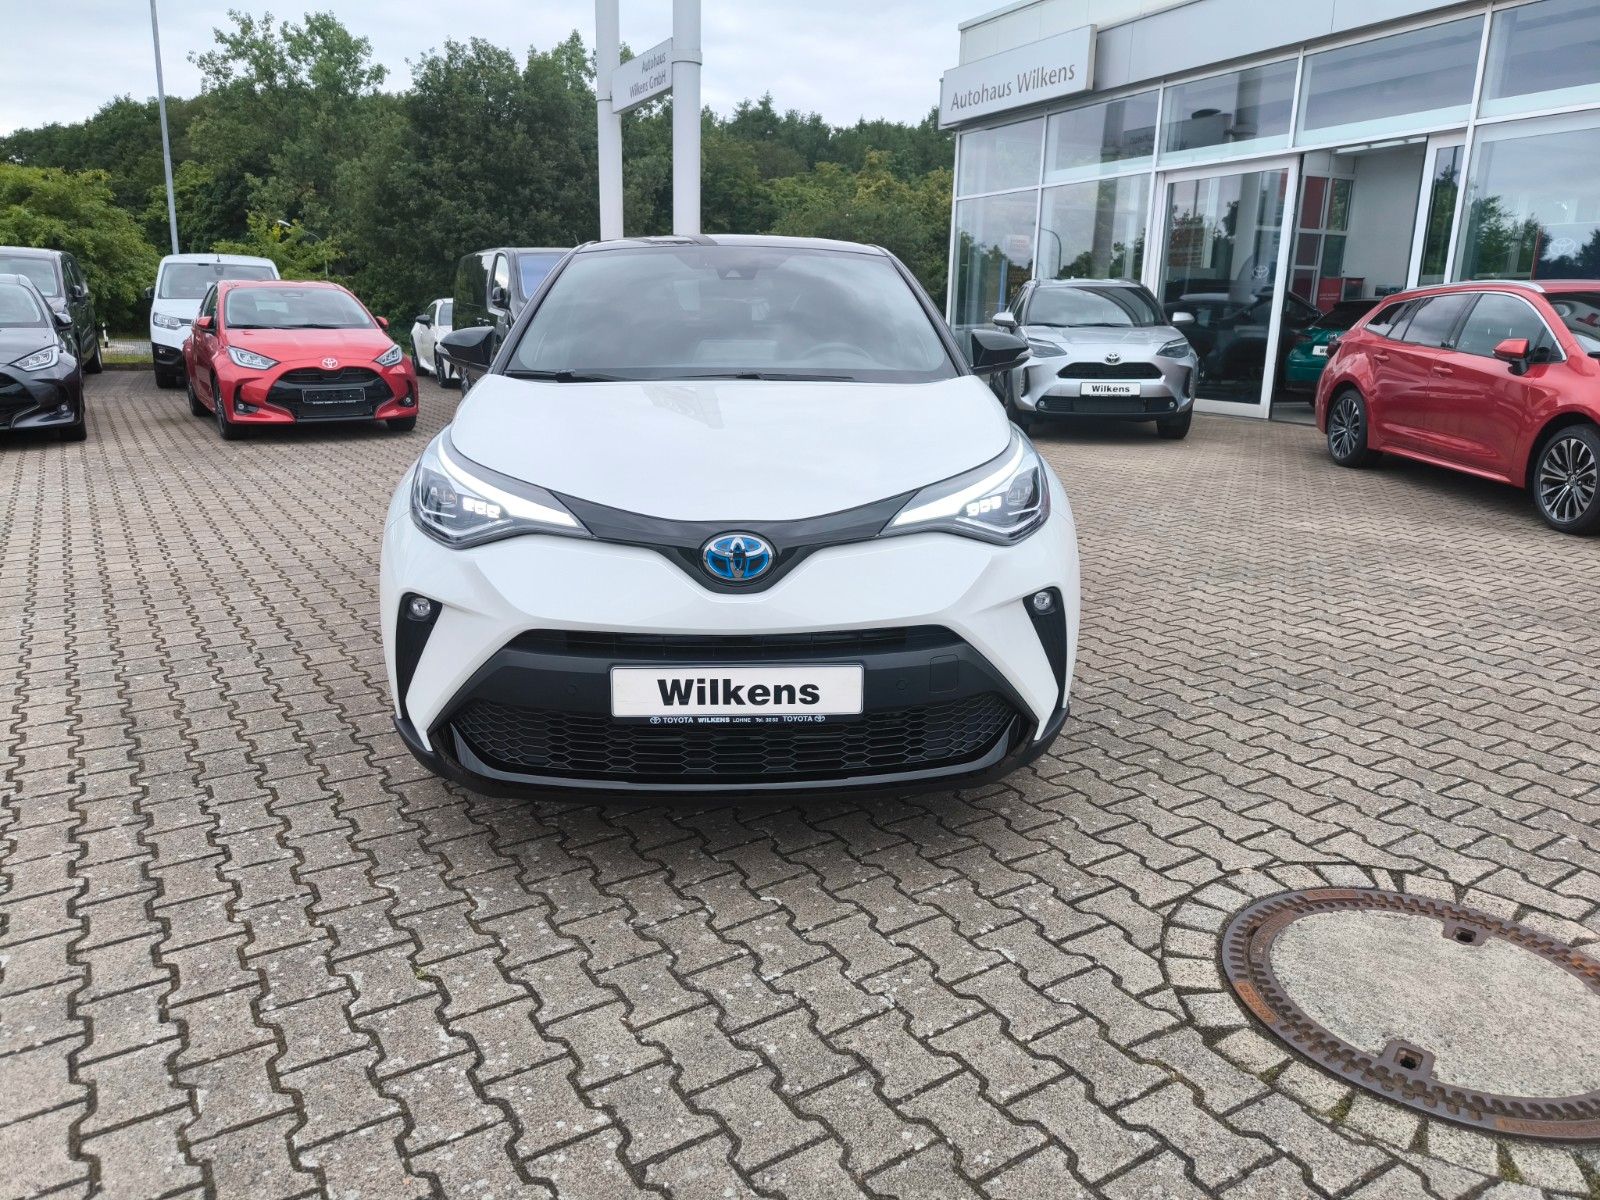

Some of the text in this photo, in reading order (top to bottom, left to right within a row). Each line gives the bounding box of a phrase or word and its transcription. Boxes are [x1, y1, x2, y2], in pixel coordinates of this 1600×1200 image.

[642, 52, 666, 74] Autohaus
[629, 70, 666, 99] Wilkens GmbH
[950, 64, 1075, 111] Autohaus Wilkens
[1091, 384, 1130, 393] Wilkens
[656, 678, 821, 706] Wilkens
[662, 716, 694, 724] TOYOTA
[697, 716, 730, 724] WILKENS
